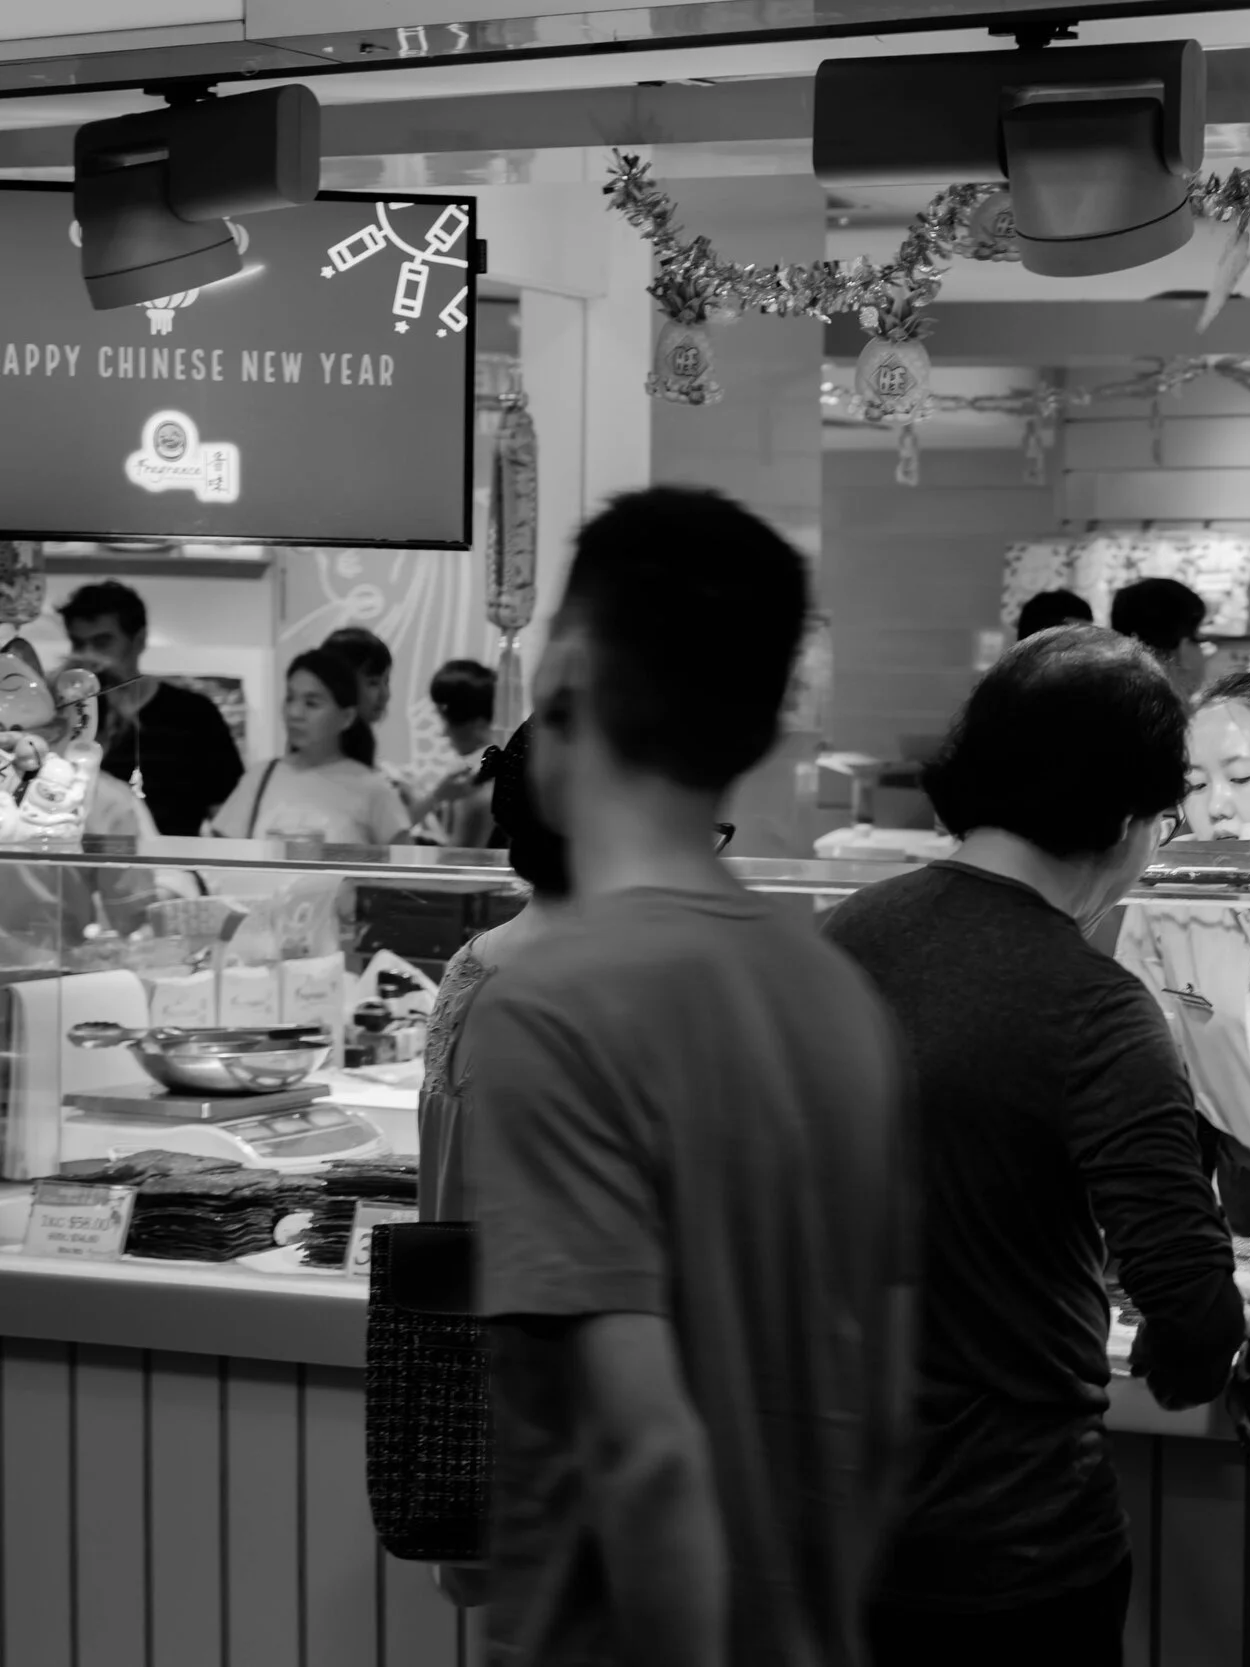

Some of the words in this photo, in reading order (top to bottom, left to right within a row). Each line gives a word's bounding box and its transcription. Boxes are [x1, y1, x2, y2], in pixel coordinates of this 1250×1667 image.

[3, 343, 81, 377] APPY
[98, 346, 224, 381] CHINESE
[242, 350, 303, 384] NEW
[320, 352, 395, 386] YEAR
